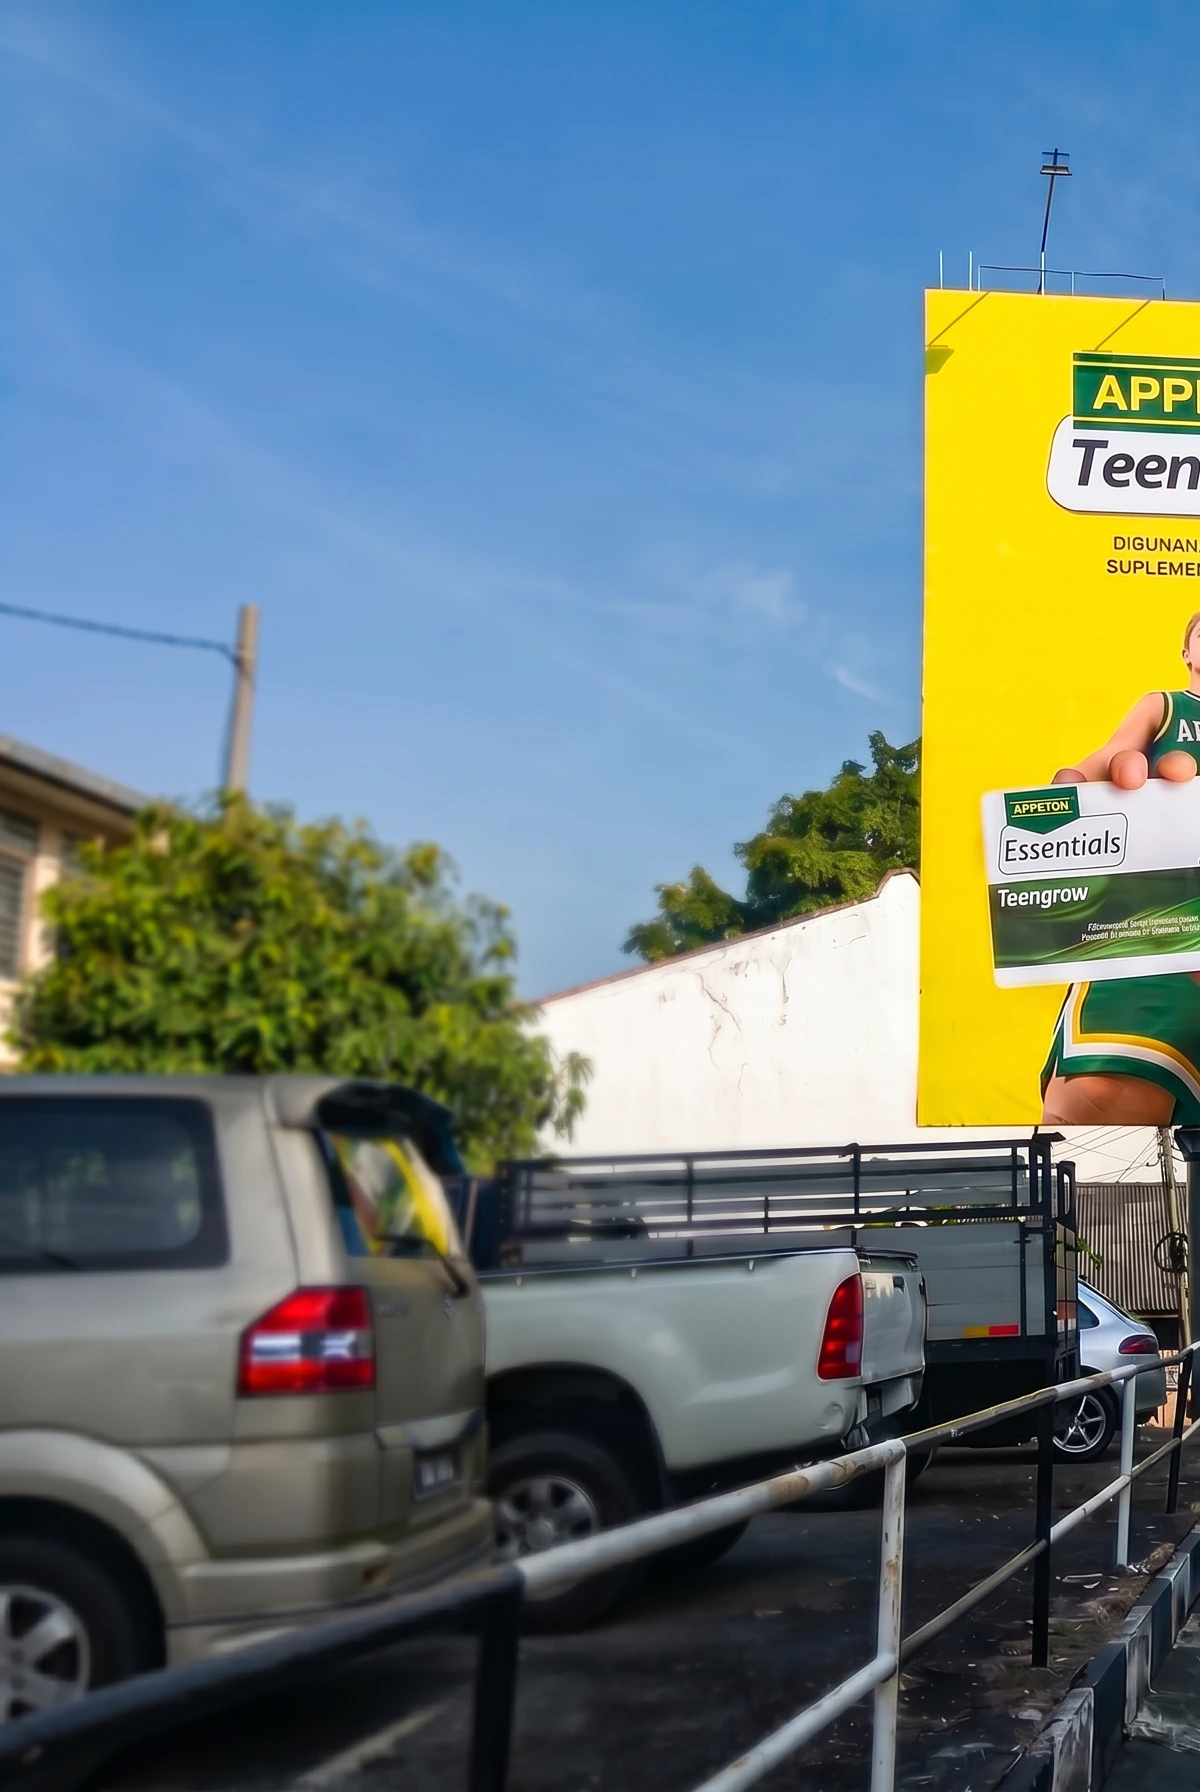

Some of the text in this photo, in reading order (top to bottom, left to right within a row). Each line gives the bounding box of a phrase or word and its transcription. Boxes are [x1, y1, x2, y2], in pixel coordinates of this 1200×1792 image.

[1013, 800, 1069, 815] APPETON
[1004, 829, 1121, 862] Essentials
[997, 886, 1089, 909] Teengrow
